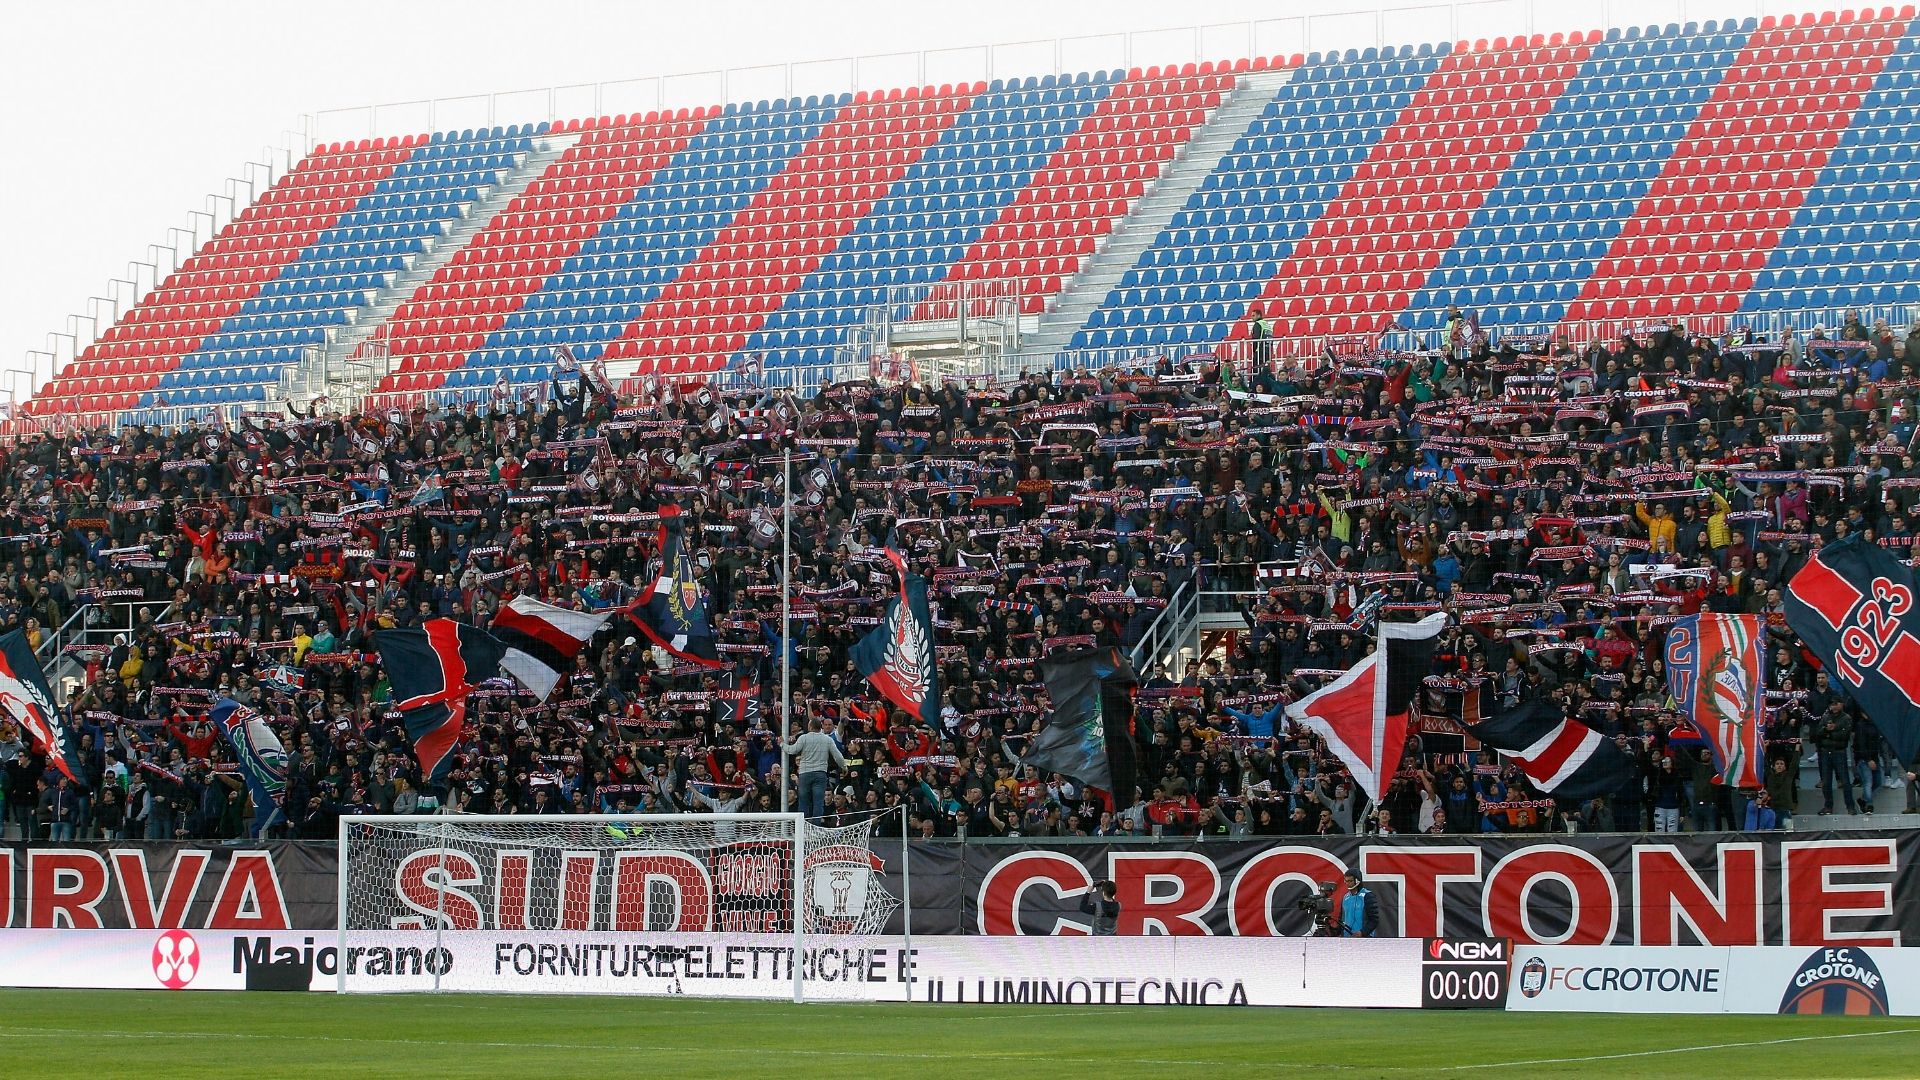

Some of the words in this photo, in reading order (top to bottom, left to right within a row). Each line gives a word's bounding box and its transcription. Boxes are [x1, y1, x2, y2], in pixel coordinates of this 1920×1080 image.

[1833, 576, 1913, 688] 1923
[1221, 697, 1246, 707] TEDDY
[1257, 693, 1278, 702] BOYS
[719, 852, 780, 897] GIORGIO
[391, 848, 716, 930] SUD
[976, 838, 1900, 946] CROTONE
[721, 910, 777, 932] VIVE
[495, 943, 675, 977] FORNITURE
[685, 945, 888, 982] ELETTRICHE
[897, 949, 919, 983] E
[1438, 941, 1501, 960] NGM
[1824, 948, 1853, 963] F.C.
[1429, 970, 1499, 1001] 00:00
[1795, 963, 1881, 990] CROTONE
